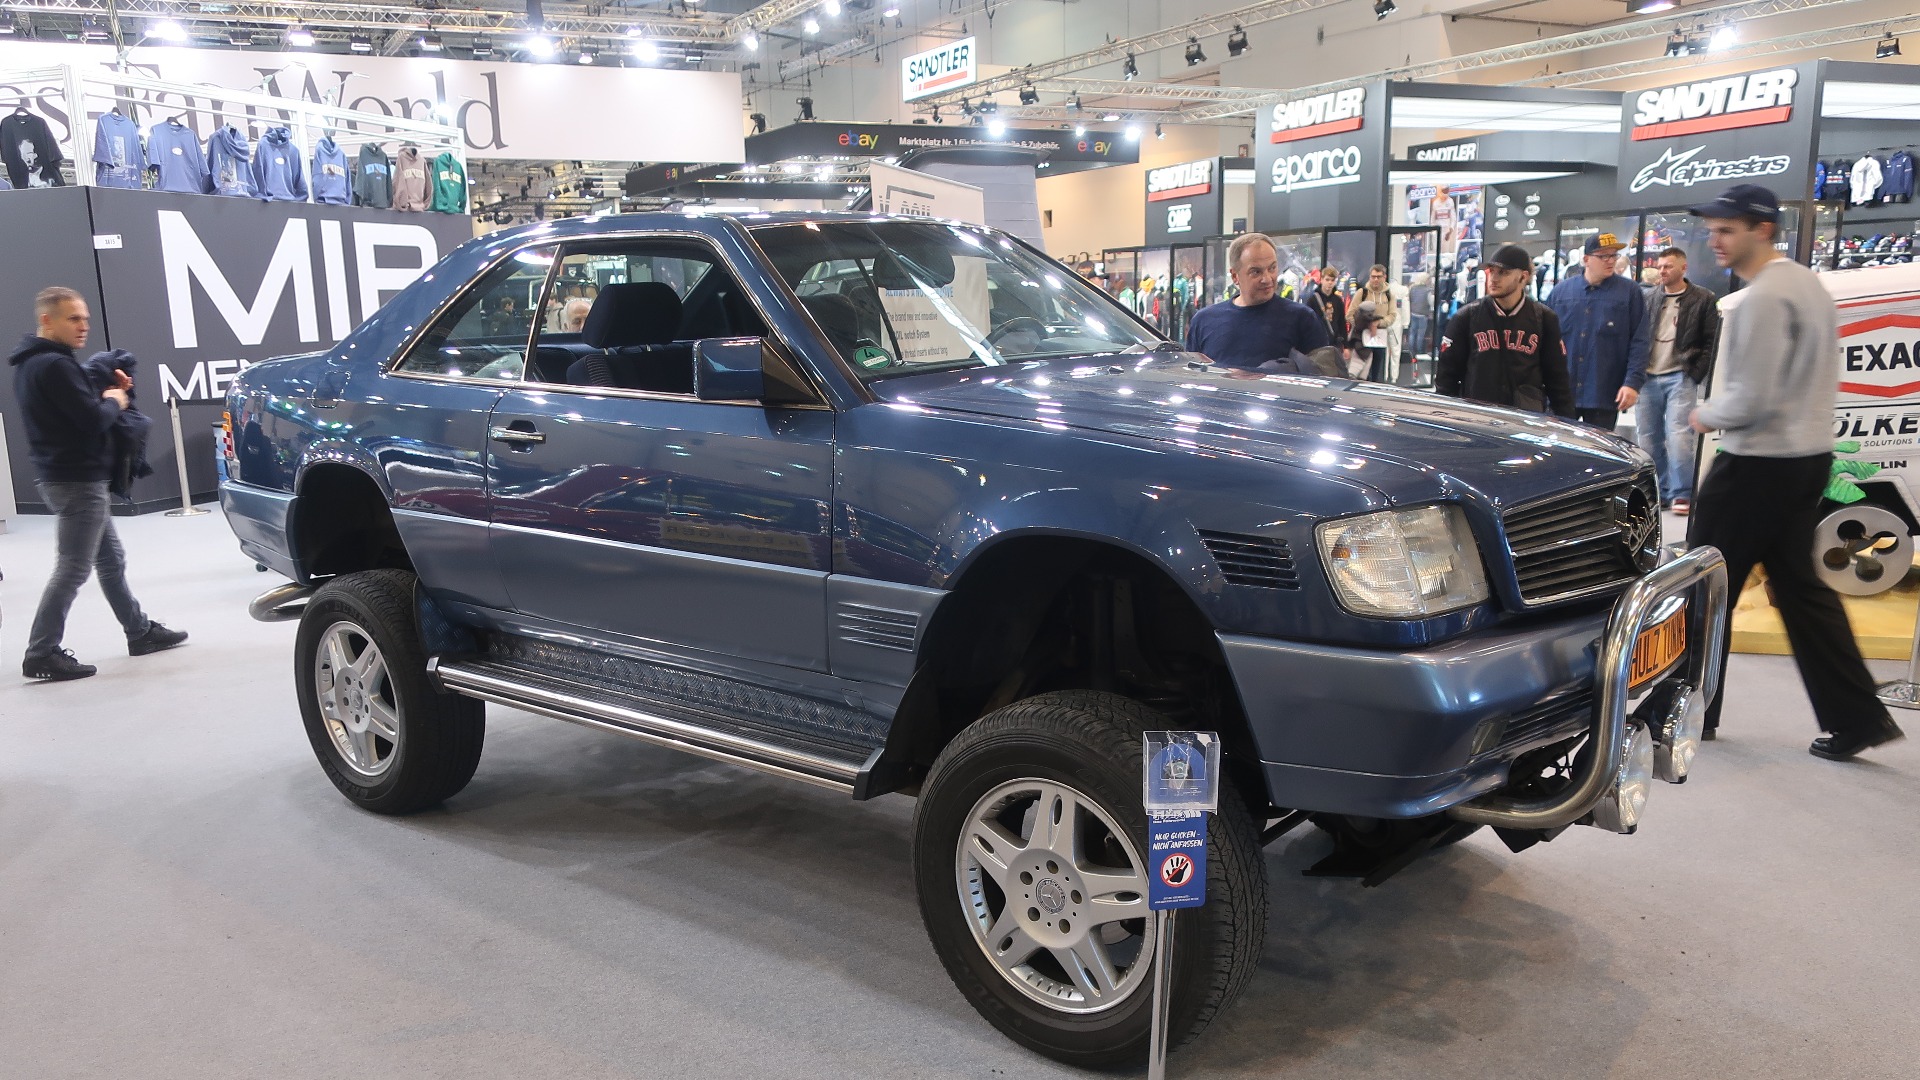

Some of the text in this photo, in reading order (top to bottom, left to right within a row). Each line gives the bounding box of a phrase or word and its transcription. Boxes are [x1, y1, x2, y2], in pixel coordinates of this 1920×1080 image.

[908, 45, 969, 82] SANDTLER
[1633, 69, 1798, 127] SANDTLER
[1271, 87, 1367, 133] SANDTLER
[838, 130, 880, 150] ebay
[899, 136, 941, 148] Marktplatz
[942, 138, 953, 146] Nr.
[1416, 143, 1477, 161] SANDTLER
[1148, 160, 1213, 193] SANDTLER
[1271, 145, 1362, 194] sparco
[863, 348, 875, 358] 4
[1474, 329, 1539, 355] BULLS
[158, 359, 252, 404] ME
[1864, 437, 1913, 448] SOLUTIONS
[1152, 838, 1204, 851] NICHT ANFASSEN
[1154, 832, 1170, 841] NUR
